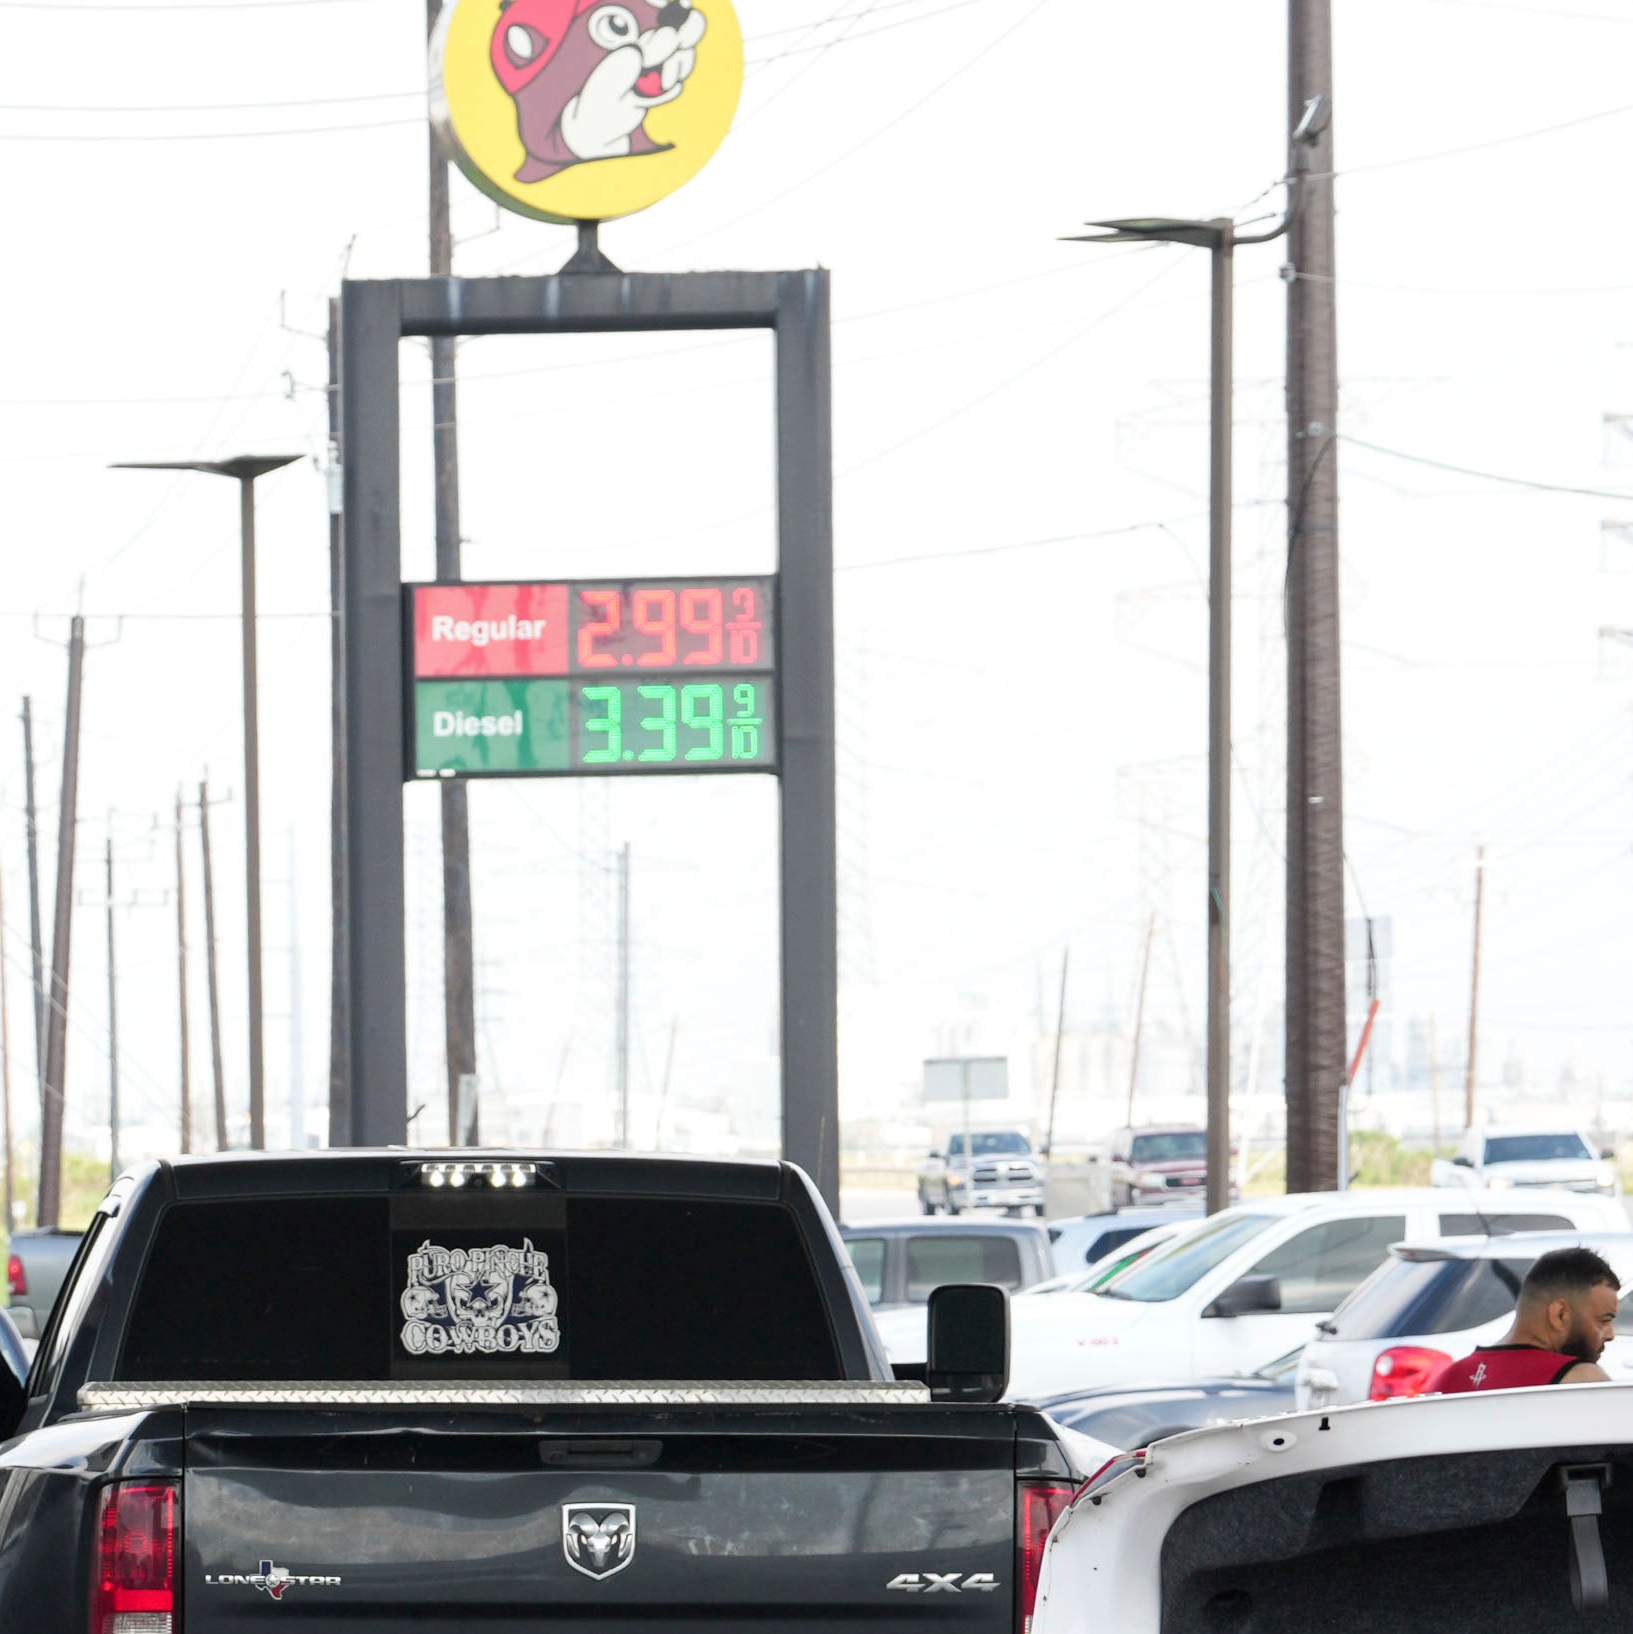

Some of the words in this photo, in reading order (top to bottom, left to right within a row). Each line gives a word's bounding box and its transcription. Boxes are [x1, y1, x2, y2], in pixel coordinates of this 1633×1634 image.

[432, 615, 546, 645] Regular
[577, 588, 723, 668] 2.99
[434, 710, 523, 737] Diesel
[582, 684, 723, 763] 3.39
[409, 1249, 467, 1286] PURO
[471, 1247, 548, 1284] PINCHE
[401, 1318, 560, 1353] COWBOYS
[205, 1574, 265, 1585] LONE
[280, 1575, 341, 1586] STAR
[886, 1573, 1001, 1592] 4X4
